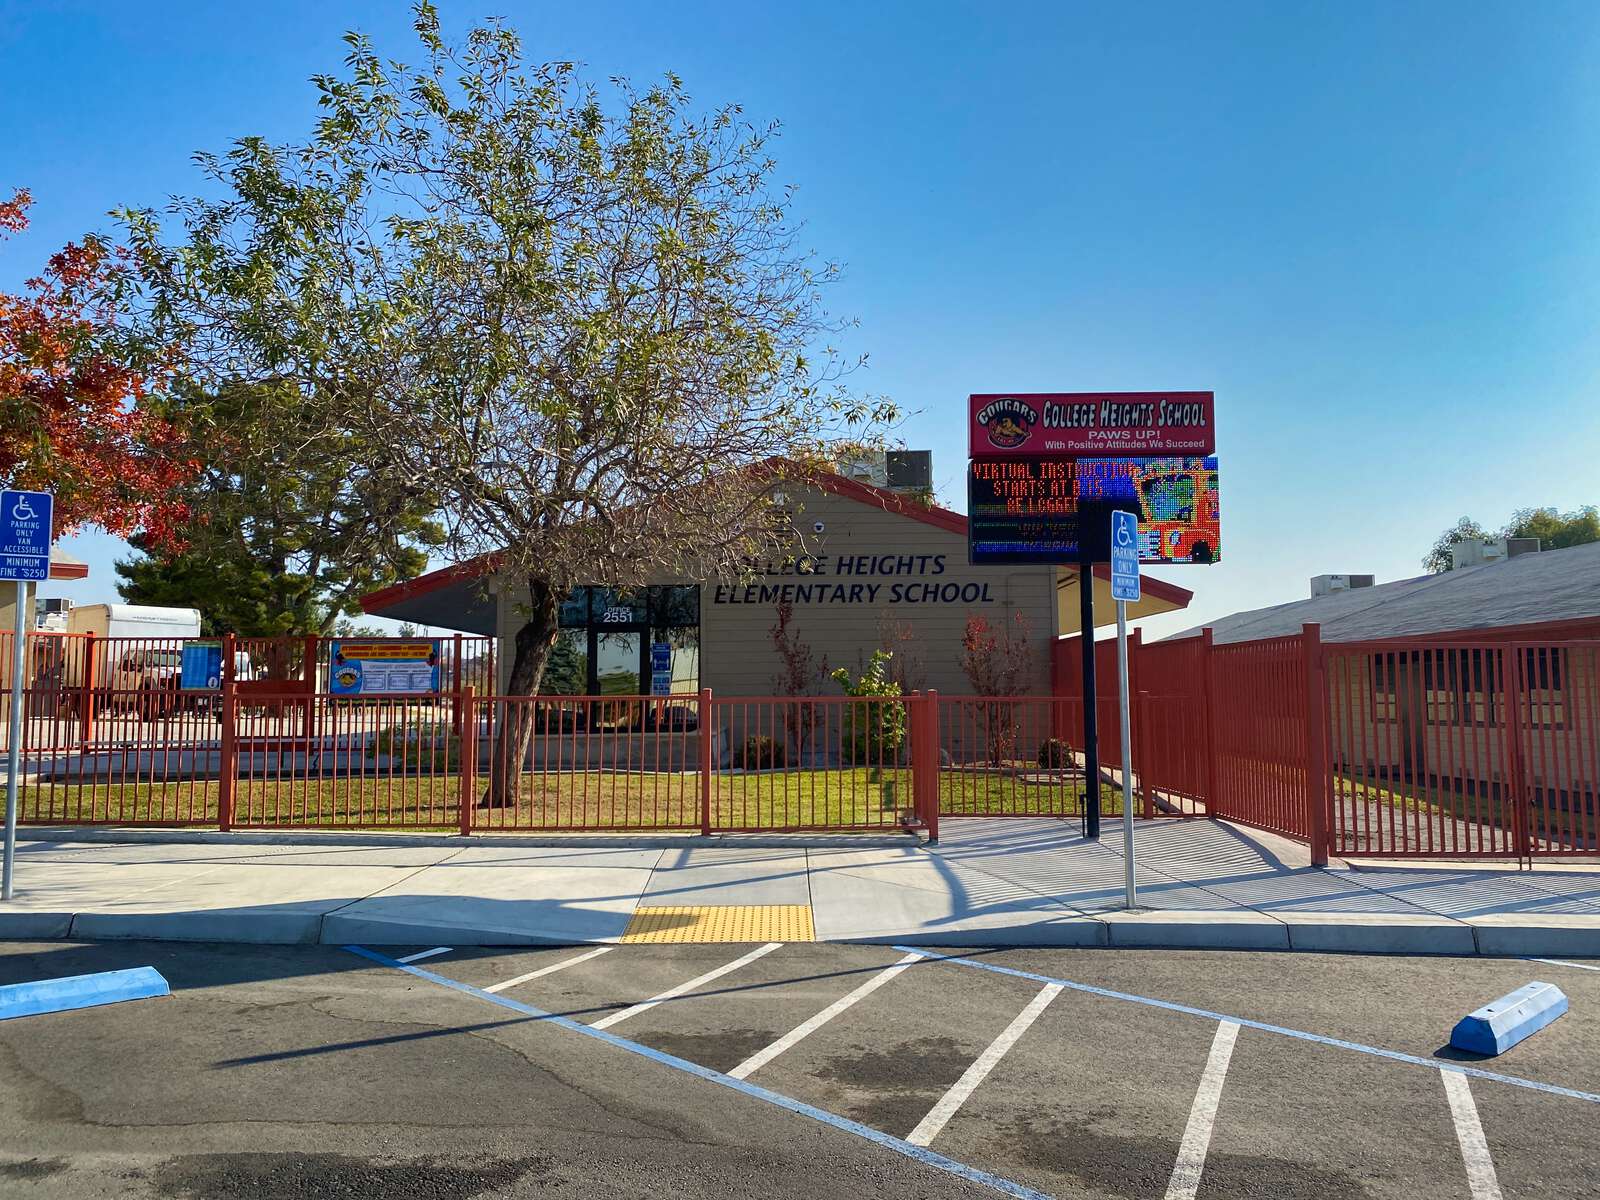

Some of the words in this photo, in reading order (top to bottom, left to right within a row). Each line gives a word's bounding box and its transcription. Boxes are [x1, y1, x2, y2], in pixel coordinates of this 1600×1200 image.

[979, 400, 1036, 424] COUGARS
[1043, 400, 1096, 428] COLLEGE
[1100, 400, 1154, 427] HEIGHTS
[1158, 399, 1206, 427] SCHOOL
[1088, 430, 1131, 439] PAWS
[1135, 430, 1161, 439] UP!
[1045, 440, 1066, 449] With
[1068, 440, 1104, 449] Positive
[1106, 440, 1147, 449] Attitudes
[1149, 440, 1164, 448] We
[1166, 439, 1205, 448] Succeed
[973, 463, 1034, 479] VIRTUAL
[993, 480, 1045, 496] STARTS
[1050, 480, 1067, 496] AT
[1007, 497, 1023, 513] BE
[10, 520, 40, 530] PARKING
[16, 529, 33, 537] ONLY
[4, 545, 44, 554] ACCESSIBLE
[1114, 546, 1137, 560] PARKING
[6, 557, 40, 567] MINIMUM
[836, 555, 946, 575] HEIGHTS
[1118, 560, 1133, 574] ONLY
[0, 567, 17, 577] FINE
[22, 568, 45, 578] $250
[714, 583, 882, 604] ELEMENTARY
[889, 582, 994, 603] SCHOOL
[603, 612, 632, 622] 2551
